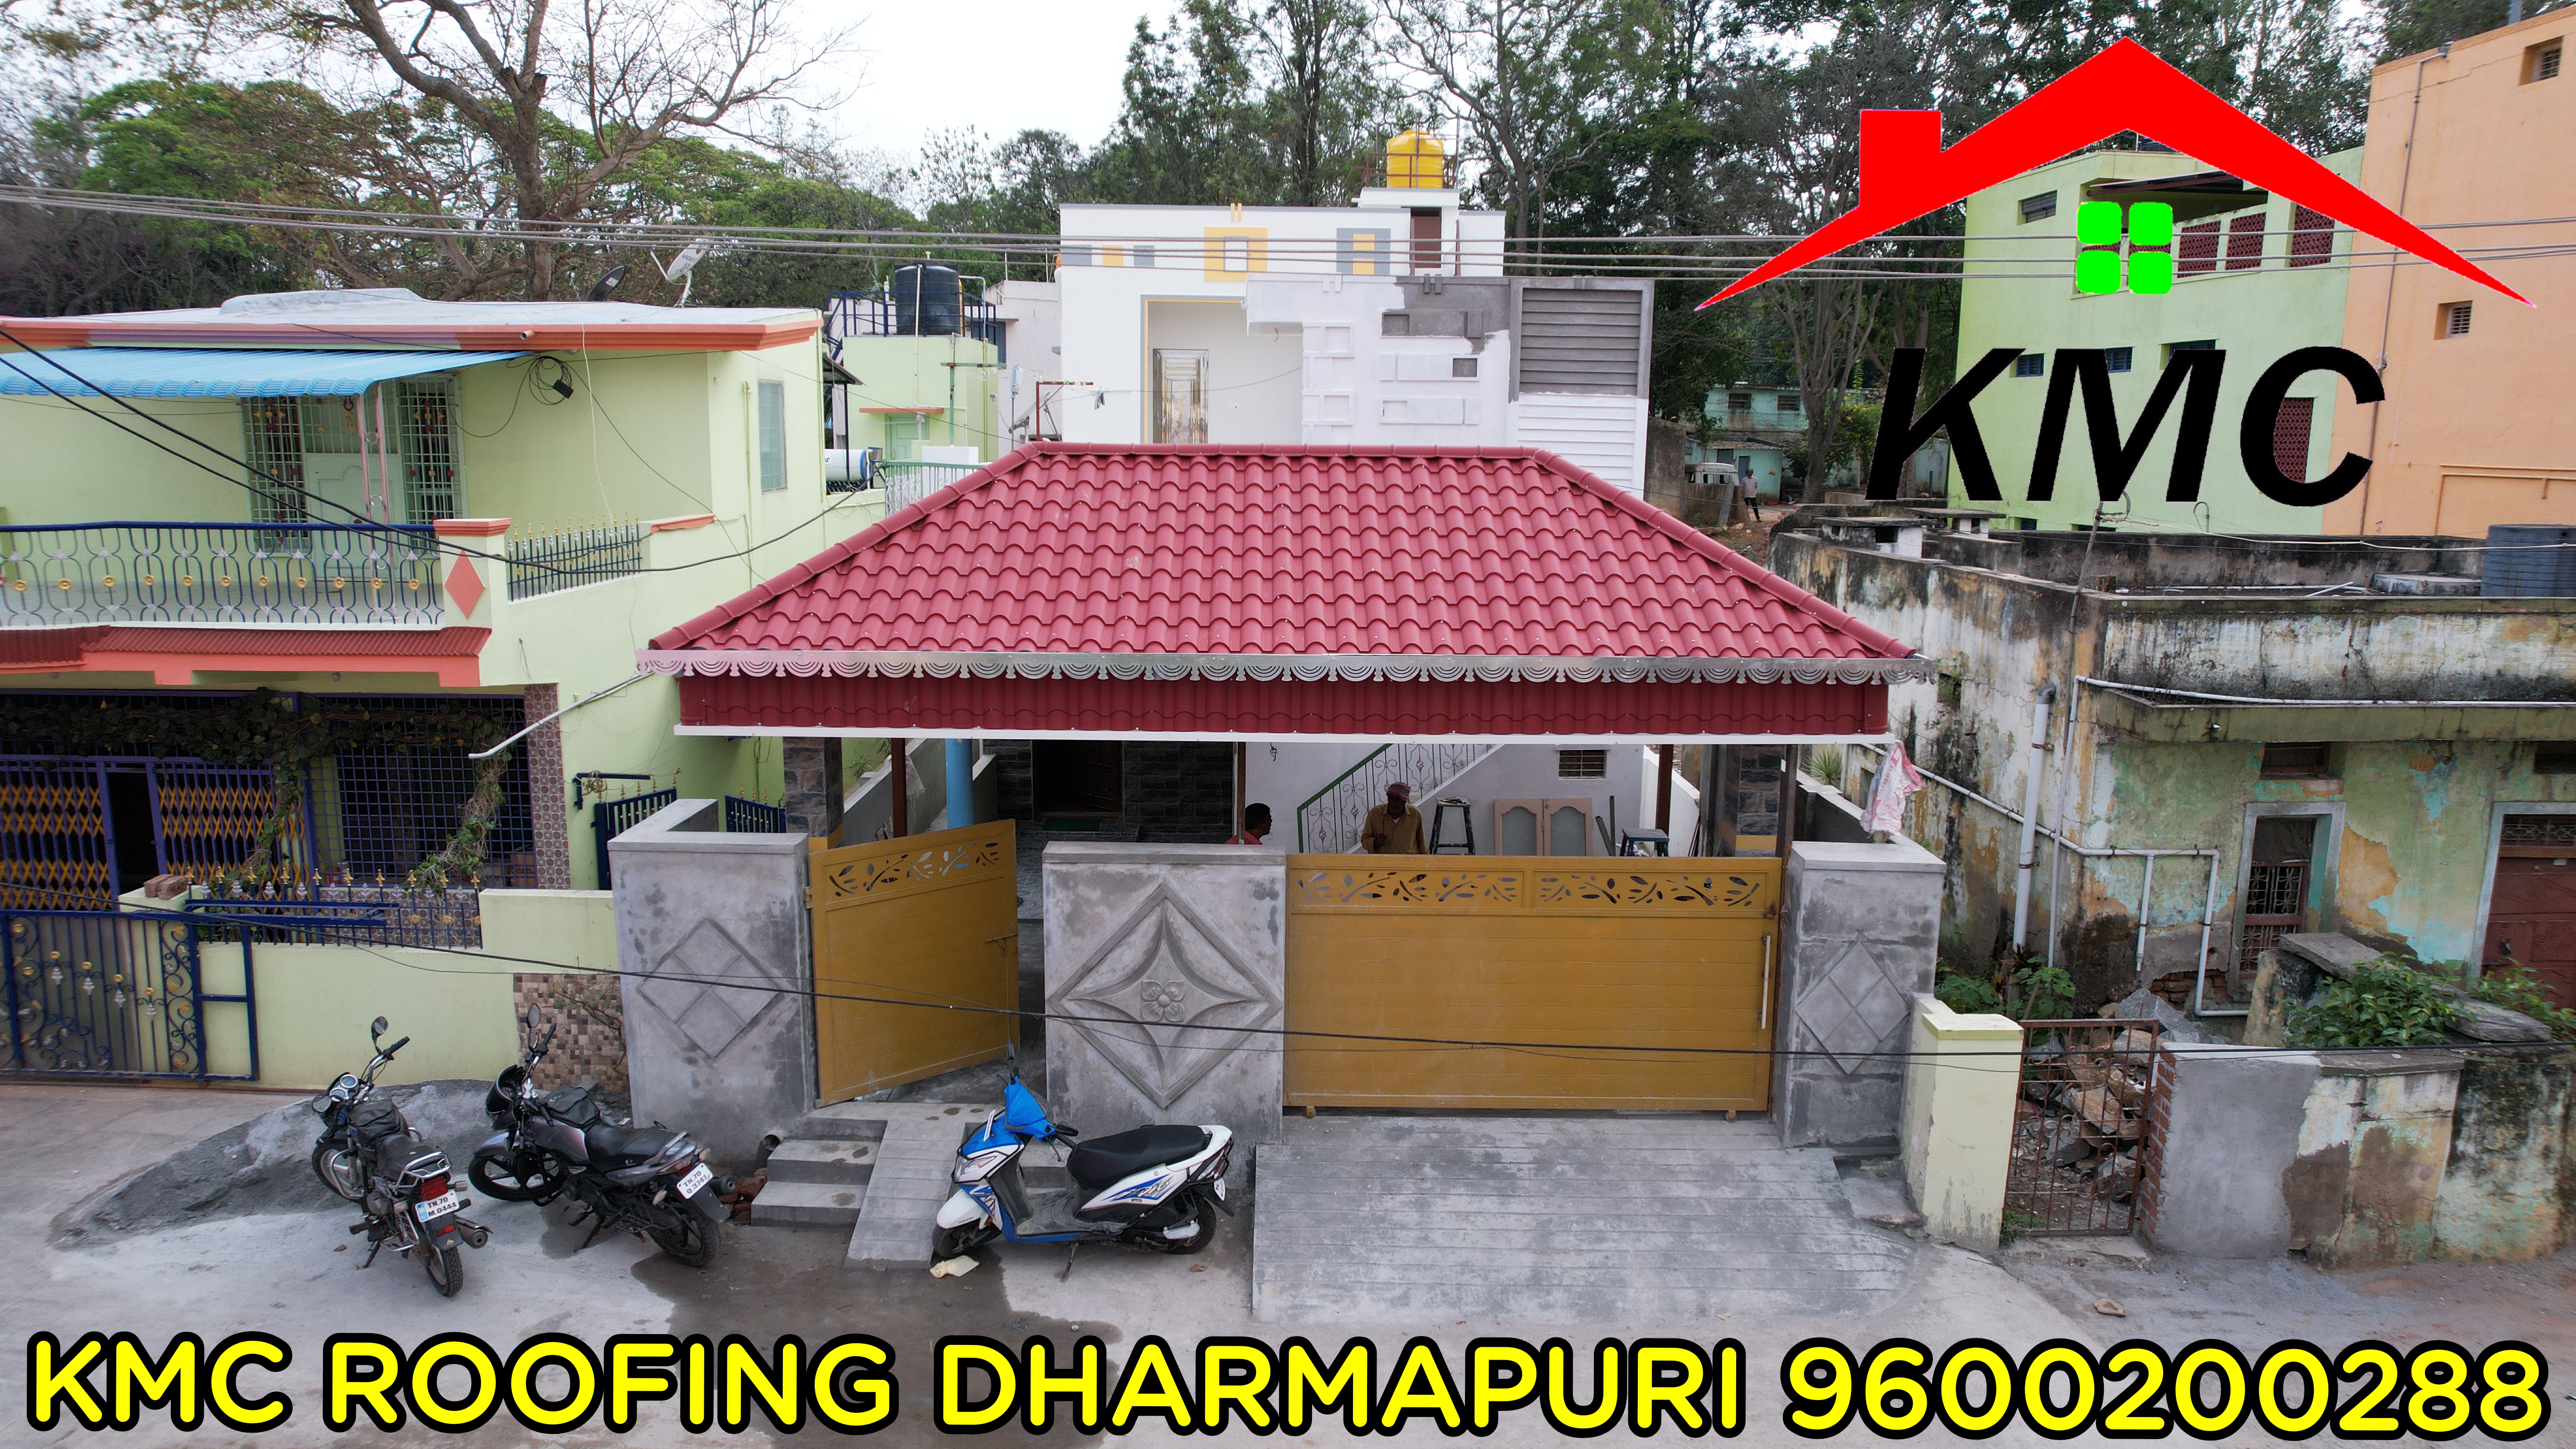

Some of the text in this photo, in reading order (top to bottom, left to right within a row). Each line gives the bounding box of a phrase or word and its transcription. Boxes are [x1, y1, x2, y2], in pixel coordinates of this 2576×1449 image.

[683, 1170, 701, 1187] TN.70
[427, 1197, 448, 1208] TN.70
[428, 1202, 457, 1217] M.0444
